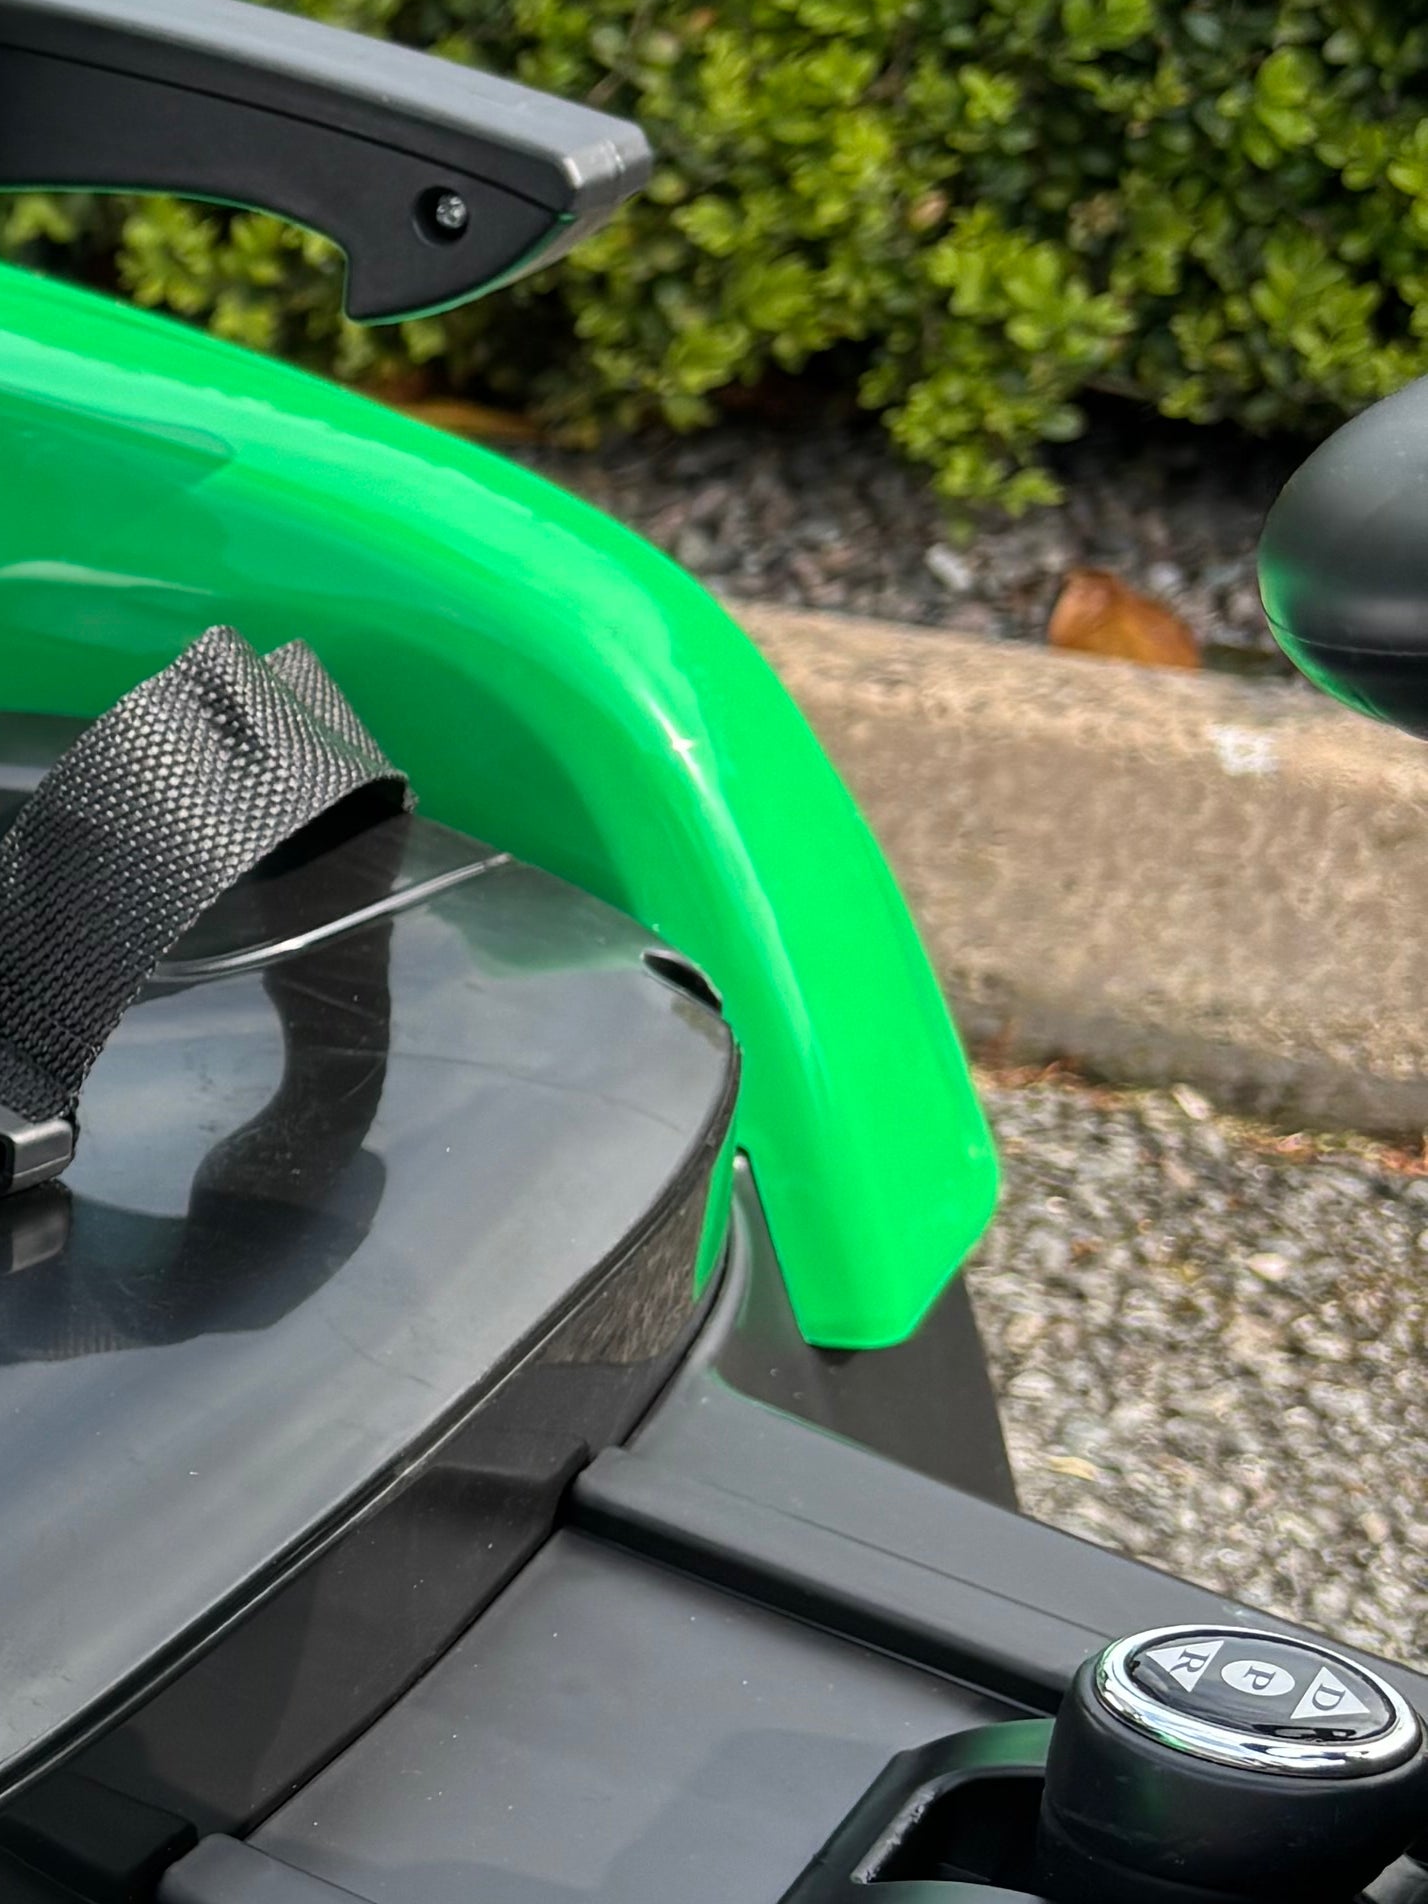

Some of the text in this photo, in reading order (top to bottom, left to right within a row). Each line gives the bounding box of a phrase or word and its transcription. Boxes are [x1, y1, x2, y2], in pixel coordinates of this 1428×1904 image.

[1169, 1647, 1210, 1674] R
[1243, 1665, 1276, 1691] P
[1311, 1682, 1346, 1711] D
